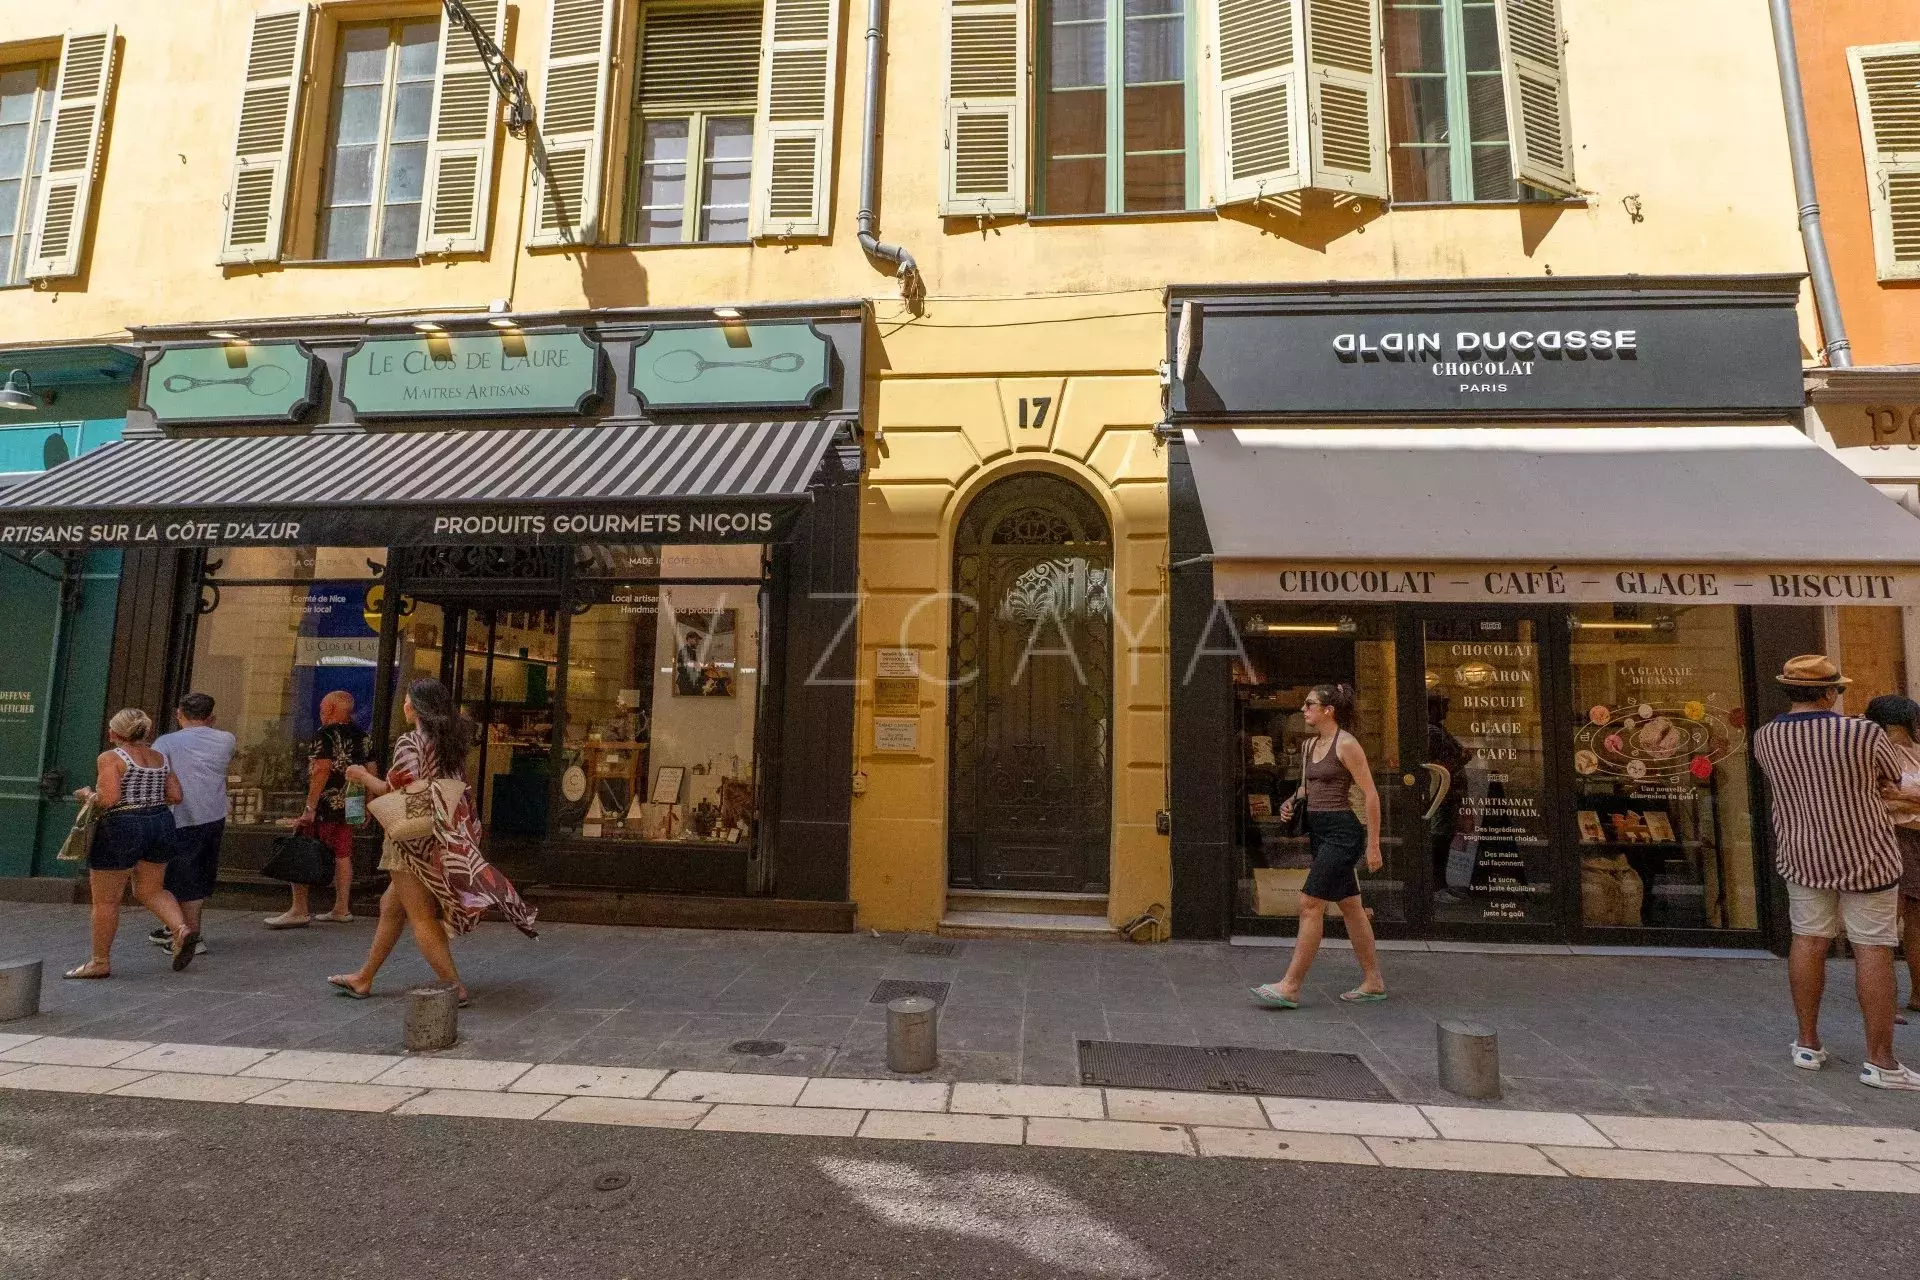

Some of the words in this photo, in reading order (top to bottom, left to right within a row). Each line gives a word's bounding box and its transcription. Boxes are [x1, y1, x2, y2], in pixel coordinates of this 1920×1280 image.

[368, 351, 393, 375] LE
[403, 350, 457, 374] CLOS
[466, 352, 491, 370] DE
[501, 349, 570, 371] LAURE
[1432, 361, 1535, 376] CHOCOLAT
[466, 384, 530, 399] ARTISANS
[1460, 383, 1508, 393] PARIS
[1019, 397, 1051, 429] 17
[433, 516, 545, 534] PRODUITS
[553, 514, 680, 533] GOURMETS
[689, 513, 772, 536] NIÇOIS
[0, 526, 83, 543] RTISANS
[89, 525, 128, 542] SUR
[134, 524, 158, 541] LA
[165, 521, 220, 540] CÔTE
[224, 522, 300, 540] D'AZUR
[629, 557, 654, 565] MADE
[1279, 570, 1435, 593] CHOCOLAT
[1484, 565, 1566, 594] CAFÉ
[1615, 571, 1718, 596] GLACE
[1768, 574, 1895, 599] BISCUIT
[292, 594, 316, 603] Comté
[317, 594, 328, 603] de
[329, 594, 347, 603] Nice
[611, 594, 632, 603] Local
[634, 594, 664, 603] artisan
[314, 605, 332, 613] local
[621, 605, 666, 614] Handmad
[317, 640, 340, 652] CLOS
[358, 640, 377, 652] LAU
[1451, 644, 1533, 656] CHOCOLAT
[1621, 667, 1635, 675] LA
[1455, 670, 1531, 682] MARON
[1632, 676, 1682, 685] DUCASSE
[1463, 696, 1526, 708] BISCUIT
[1470, 722, 1521, 734] GLACE
[1629, 792, 1667, 800] dimension
[1462, 797, 1475, 805] UN
[1478, 797, 1534, 806] ARTISANAT
[1459, 808, 1540, 817] CONTEMPORAIN.
[1463, 835, 1513, 843] soigneusement
[1488, 884, 1505, 892] juste
[1500, 902, 1516, 910] goût
[1509, 910, 1524, 918] goût
